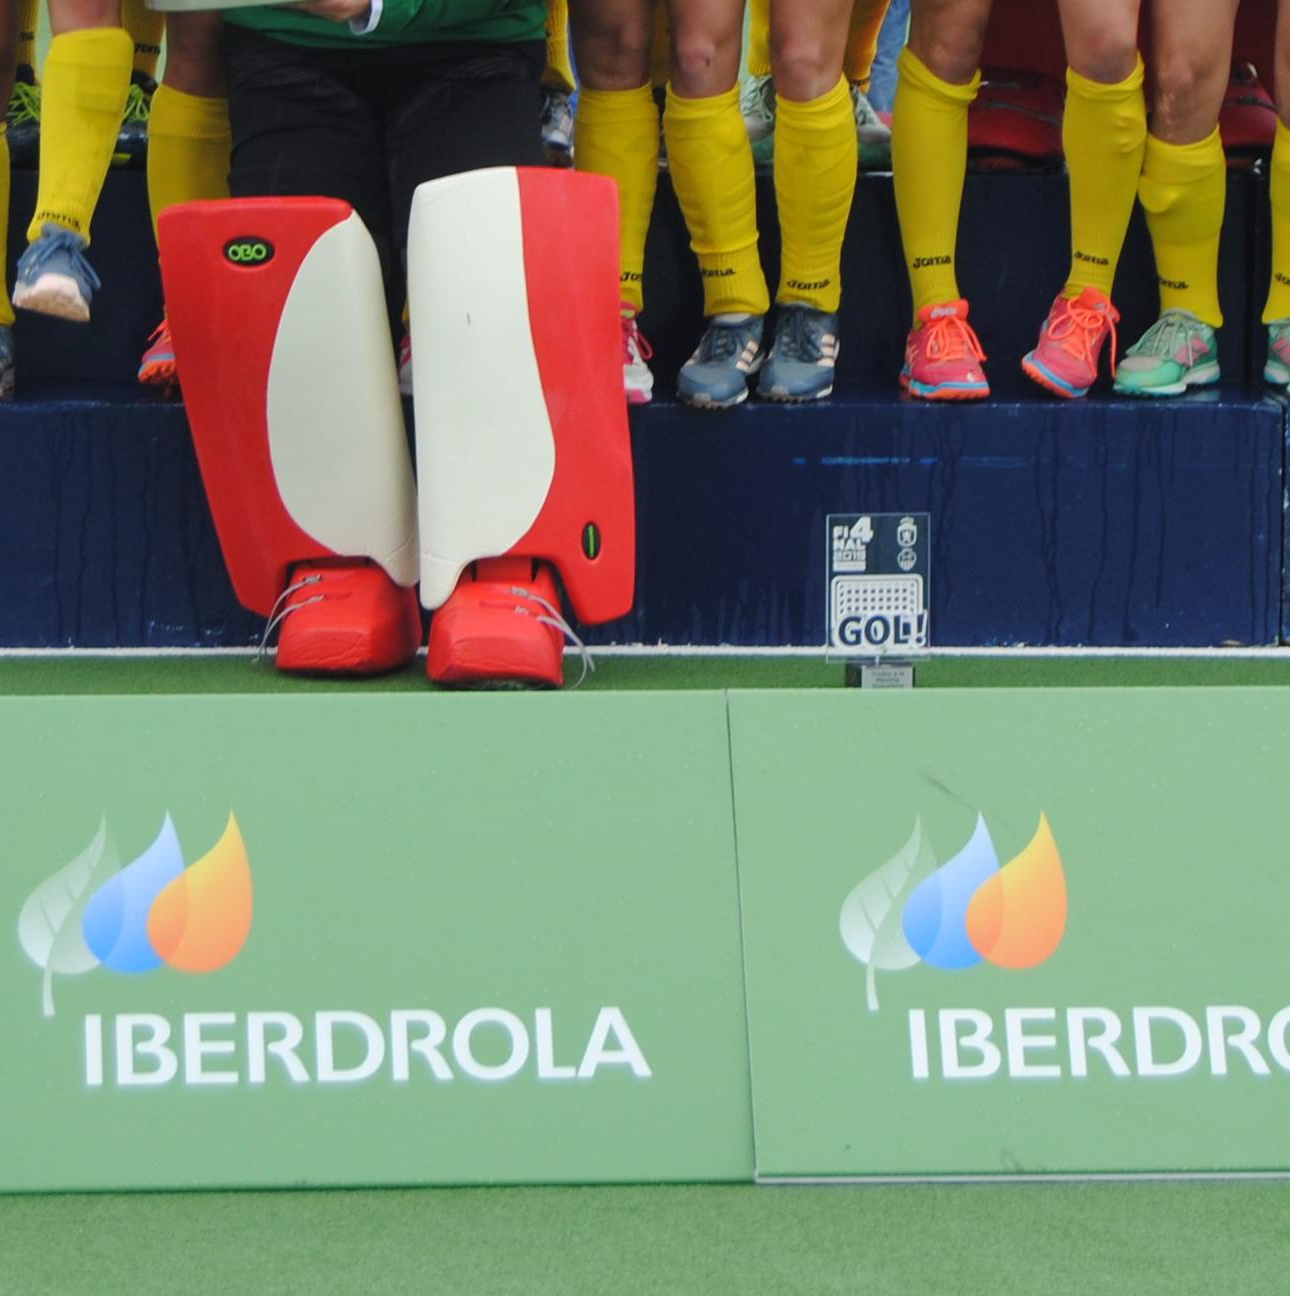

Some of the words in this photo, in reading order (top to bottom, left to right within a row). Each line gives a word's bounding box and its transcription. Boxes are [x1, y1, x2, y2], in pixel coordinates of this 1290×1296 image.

[228, 243, 267, 261] OBO
[913, 255, 951, 269] Joma
[84, 1006, 653, 1085] IBERDROLA
